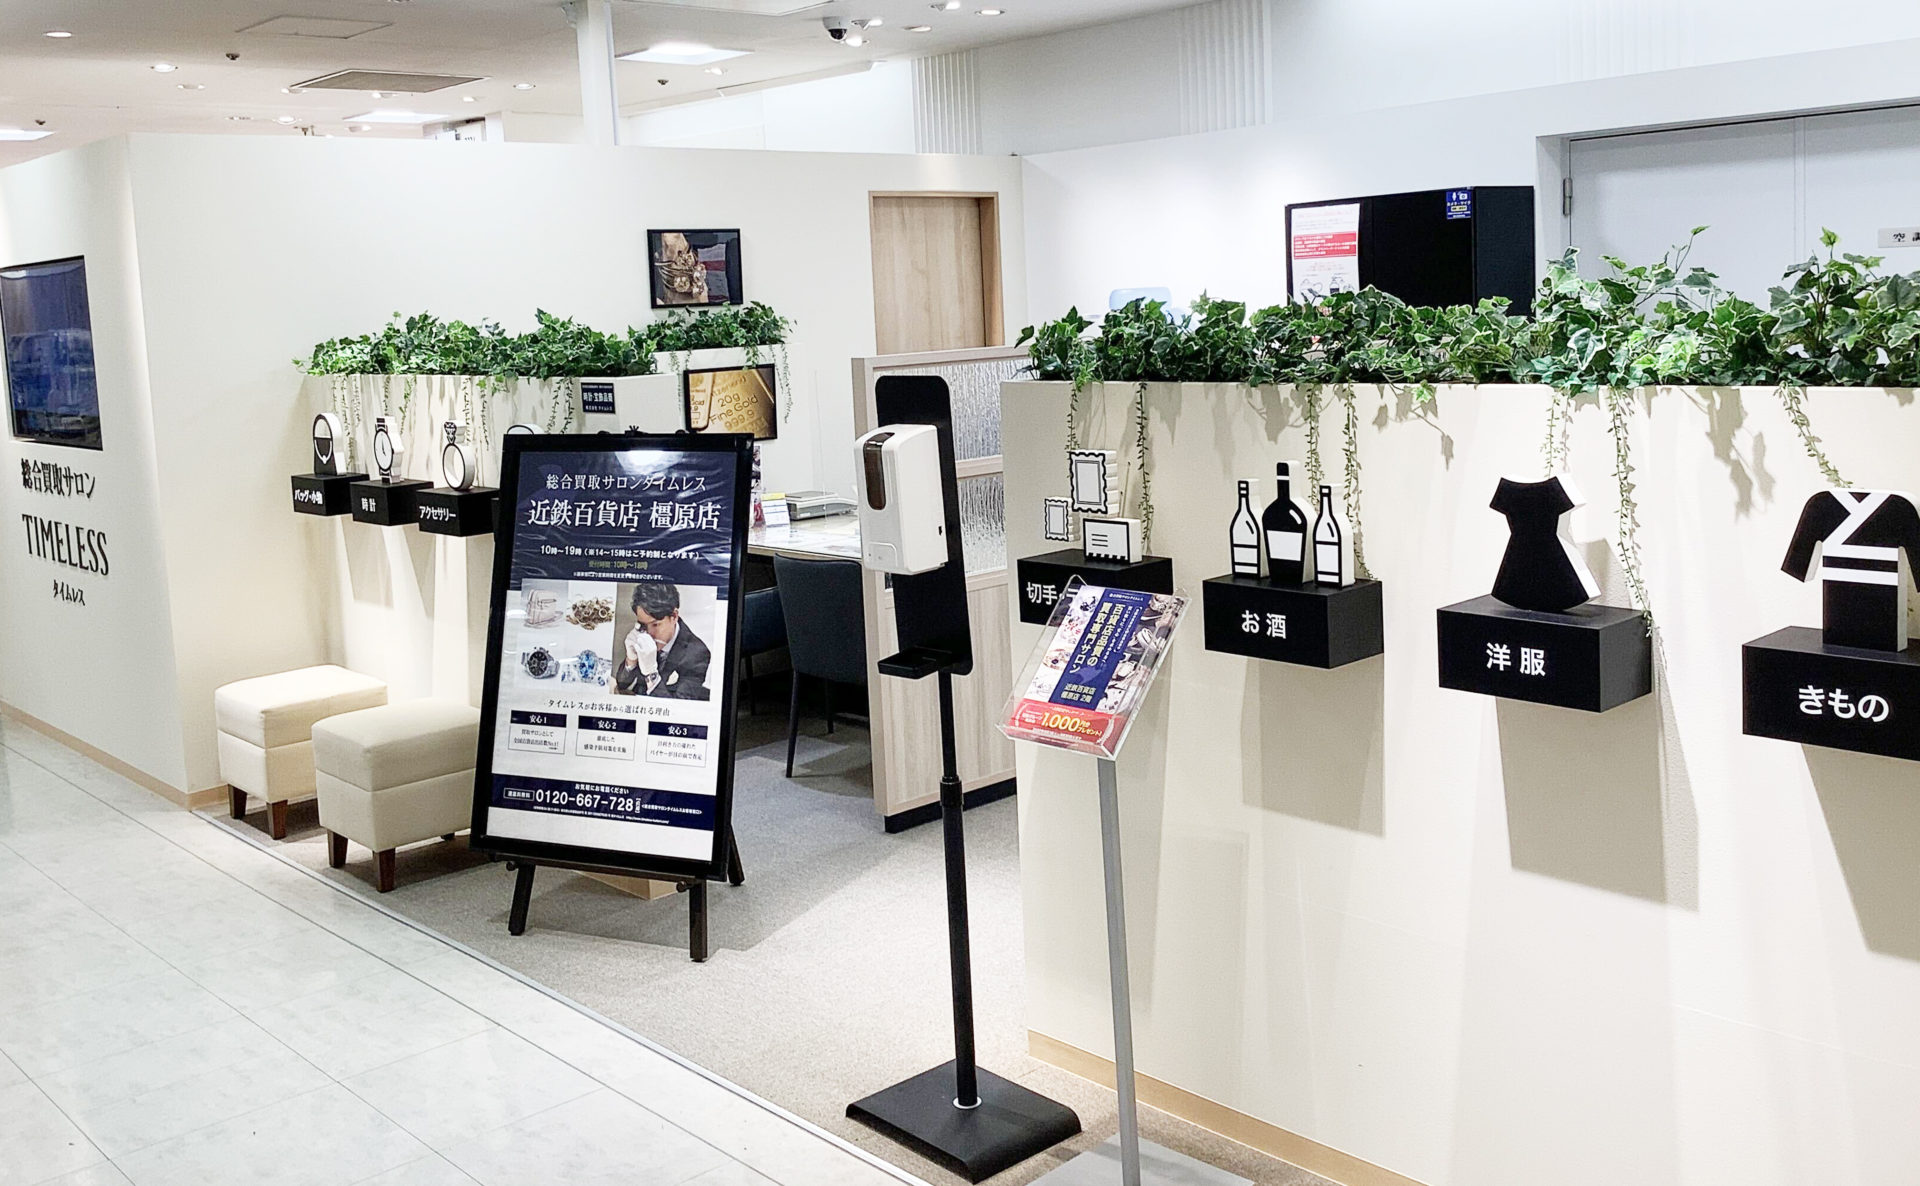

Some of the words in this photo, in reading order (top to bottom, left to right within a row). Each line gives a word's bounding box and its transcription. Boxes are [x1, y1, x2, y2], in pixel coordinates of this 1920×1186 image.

[709, 408, 733, 425] Fine
[734, 394, 759, 412] Gold
[717, 392, 741, 408] 20g
[21, 458, 96, 498] 総合買取サロン
[546, 473, 706, 491] 総合買取サロンタイムレス
[294, 489, 323, 505] バッグ・小物
[361, 497, 376, 512] 時計
[419, 505, 457, 522] アクセサリー
[527, 499, 642, 529] 近鉄百貨店
[649, 501, 722, 531] 橿原店
[22, 513, 109, 576] TIMELESS
[53, 579, 86, 606] タイムレス
[1069, 602, 1114, 674] 買取専門サロン
[1086, 603, 1126, 667] 百貨店品質の
[1241, 609, 1287, 639] お酒
[1485, 642, 1546, 677] 洋服
[549, 699, 671, 717] タイムレスがお客様から選ばれる理由
[1798, 684, 1890, 723] きもの
[535, 789, 634, 812] 0120-667-728
[574, 783, 629, 795] お気軽にお電話ください
